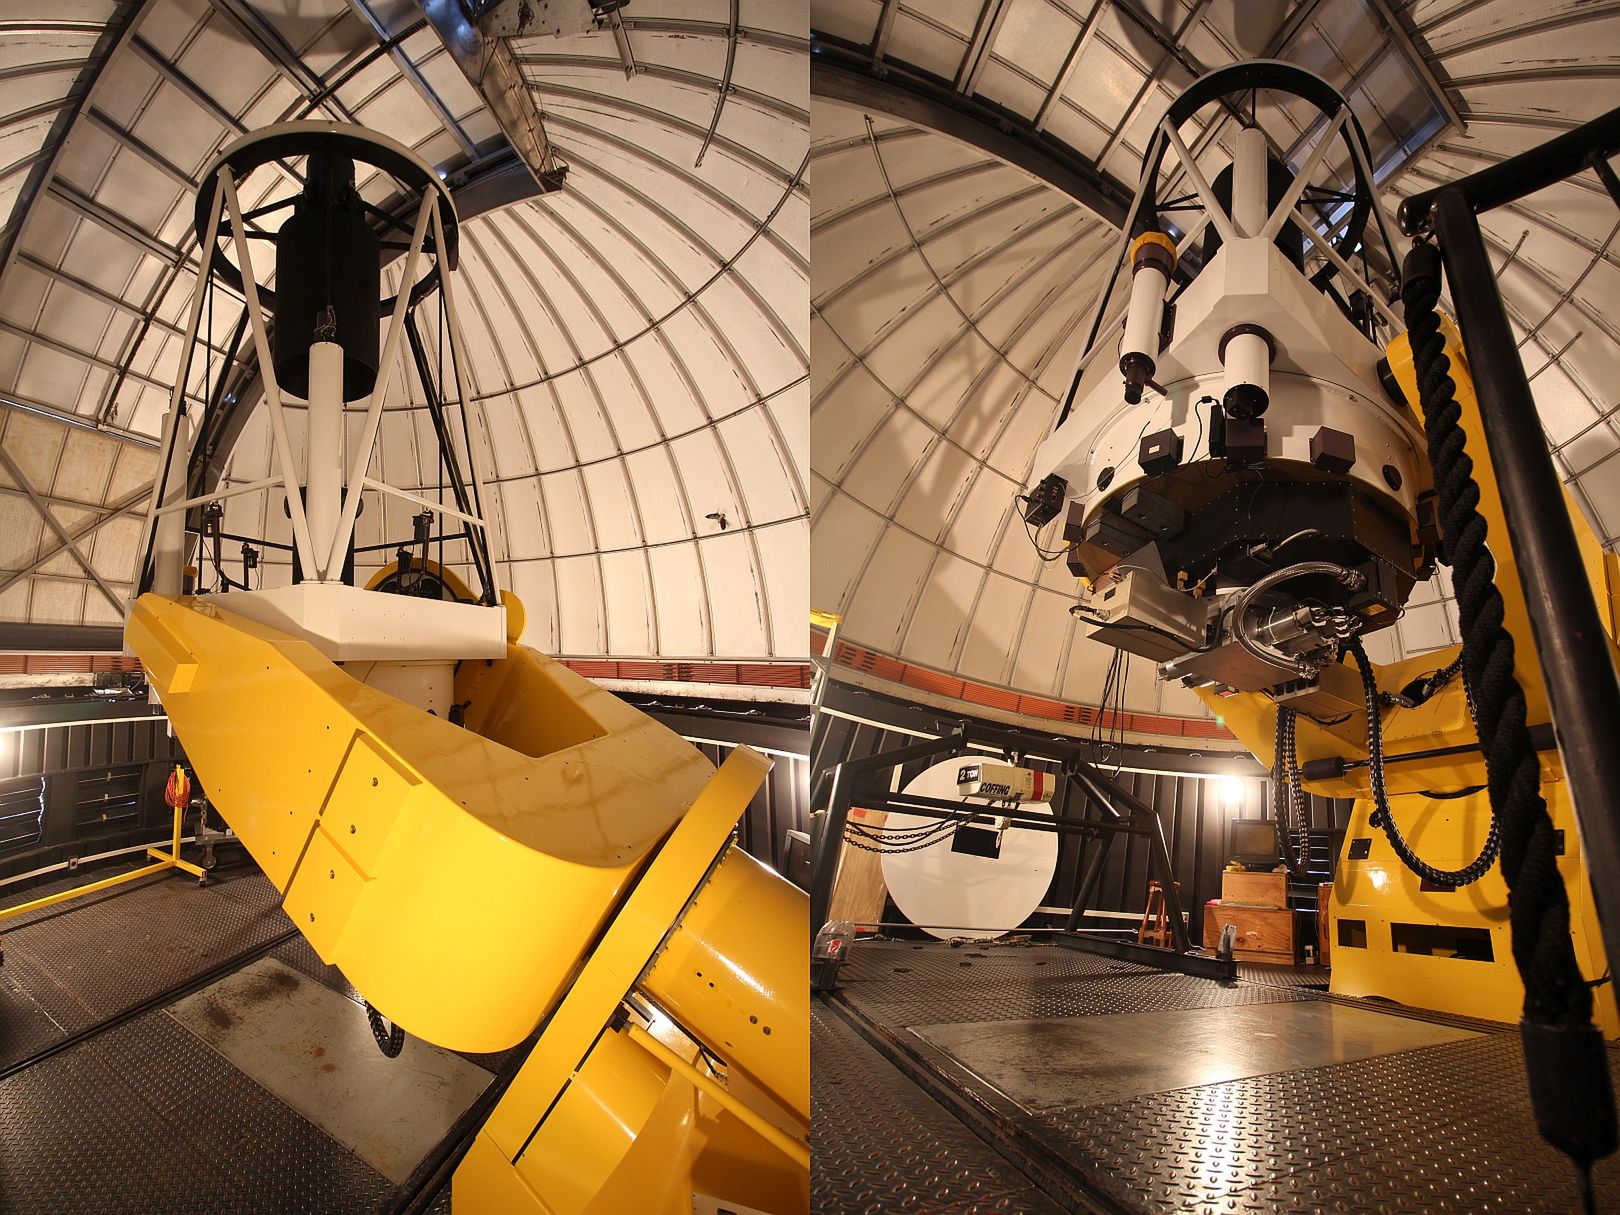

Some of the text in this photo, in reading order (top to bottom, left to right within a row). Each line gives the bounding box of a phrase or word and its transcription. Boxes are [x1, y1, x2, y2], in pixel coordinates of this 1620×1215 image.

[959, 768, 979, 781] 2 TON
[980, 782, 1011, 796] COFFING
